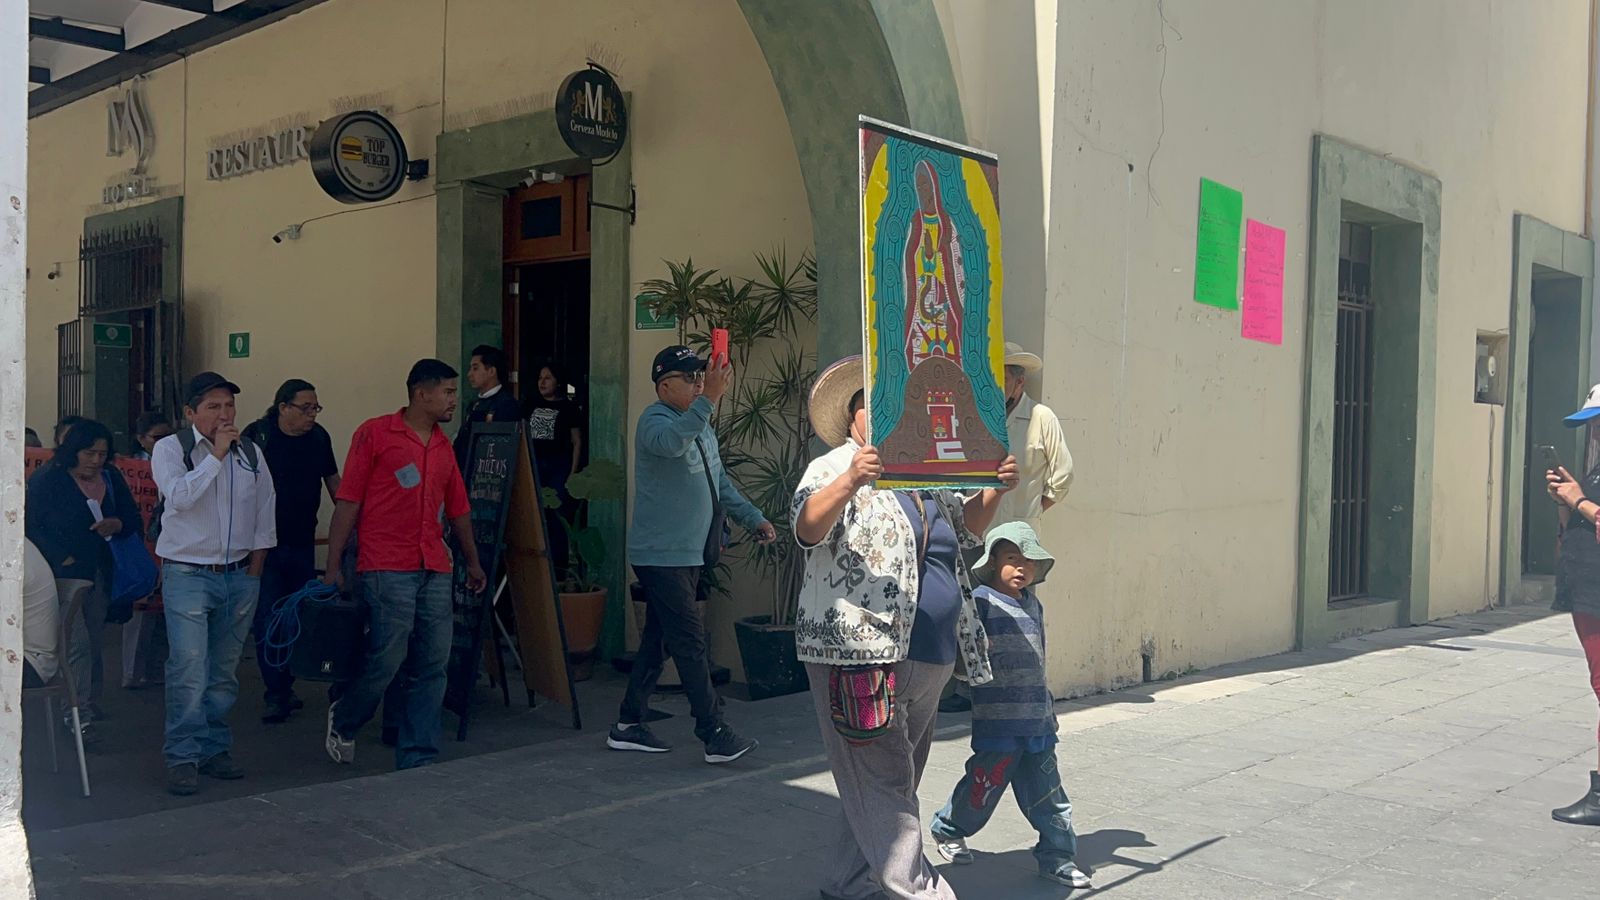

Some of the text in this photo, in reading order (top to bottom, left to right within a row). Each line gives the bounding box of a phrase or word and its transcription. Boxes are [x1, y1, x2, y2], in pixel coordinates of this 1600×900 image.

[585, 81, 603, 122] M
[570, 119, 595, 135] Cerveza
[366, 138, 386, 153] TOP
[363, 152, 390, 167] BURGER
[103, 175, 151, 204] HOTEL
